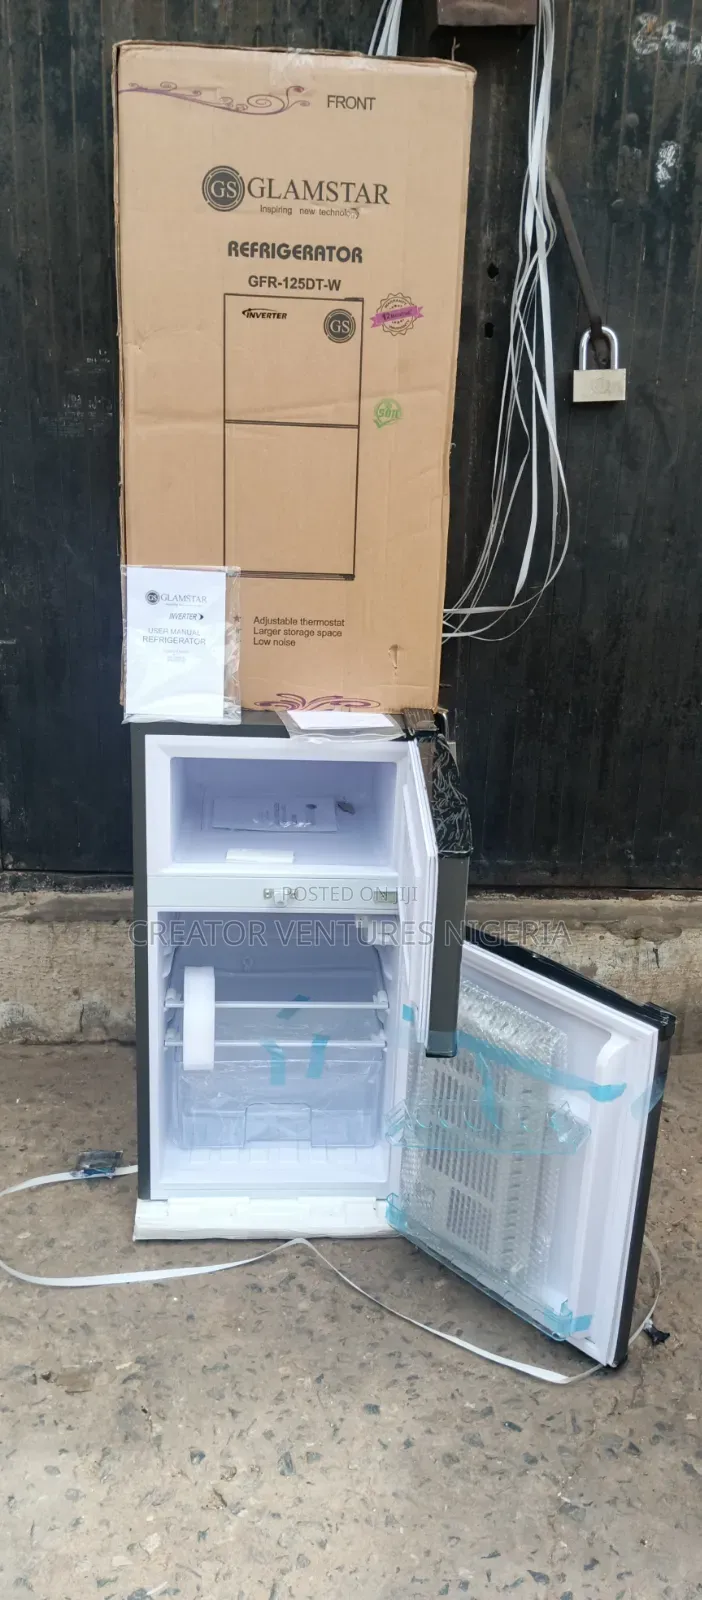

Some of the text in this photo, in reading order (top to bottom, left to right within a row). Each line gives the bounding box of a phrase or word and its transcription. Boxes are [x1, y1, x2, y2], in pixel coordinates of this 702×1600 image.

[327, 94, 376, 111] FRONT
[210, 180, 238, 199] GS
[247, 176, 390, 205] GLAMSTAR
[259, 204, 360, 219] Inspiring new technoloy
[227, 240, 363, 264] REFRIGERATOR
[247, 274, 342, 292] GFR-125DT-W
[245, 308, 288, 320] INVERTER
[329, 319, 351, 334] GS
[160, 593, 208, 604] GLAMSTAR
[168, 612, 198, 621] INVERTER
[253, 616, 346, 627] Adjustable thermostat
[148, 627, 201, 636] USER MANUAL
[253, 626, 343, 639] Larger storage space
[142, 635, 206, 646] REFRIGERATOR
[253, 637, 296, 647] Low noise
